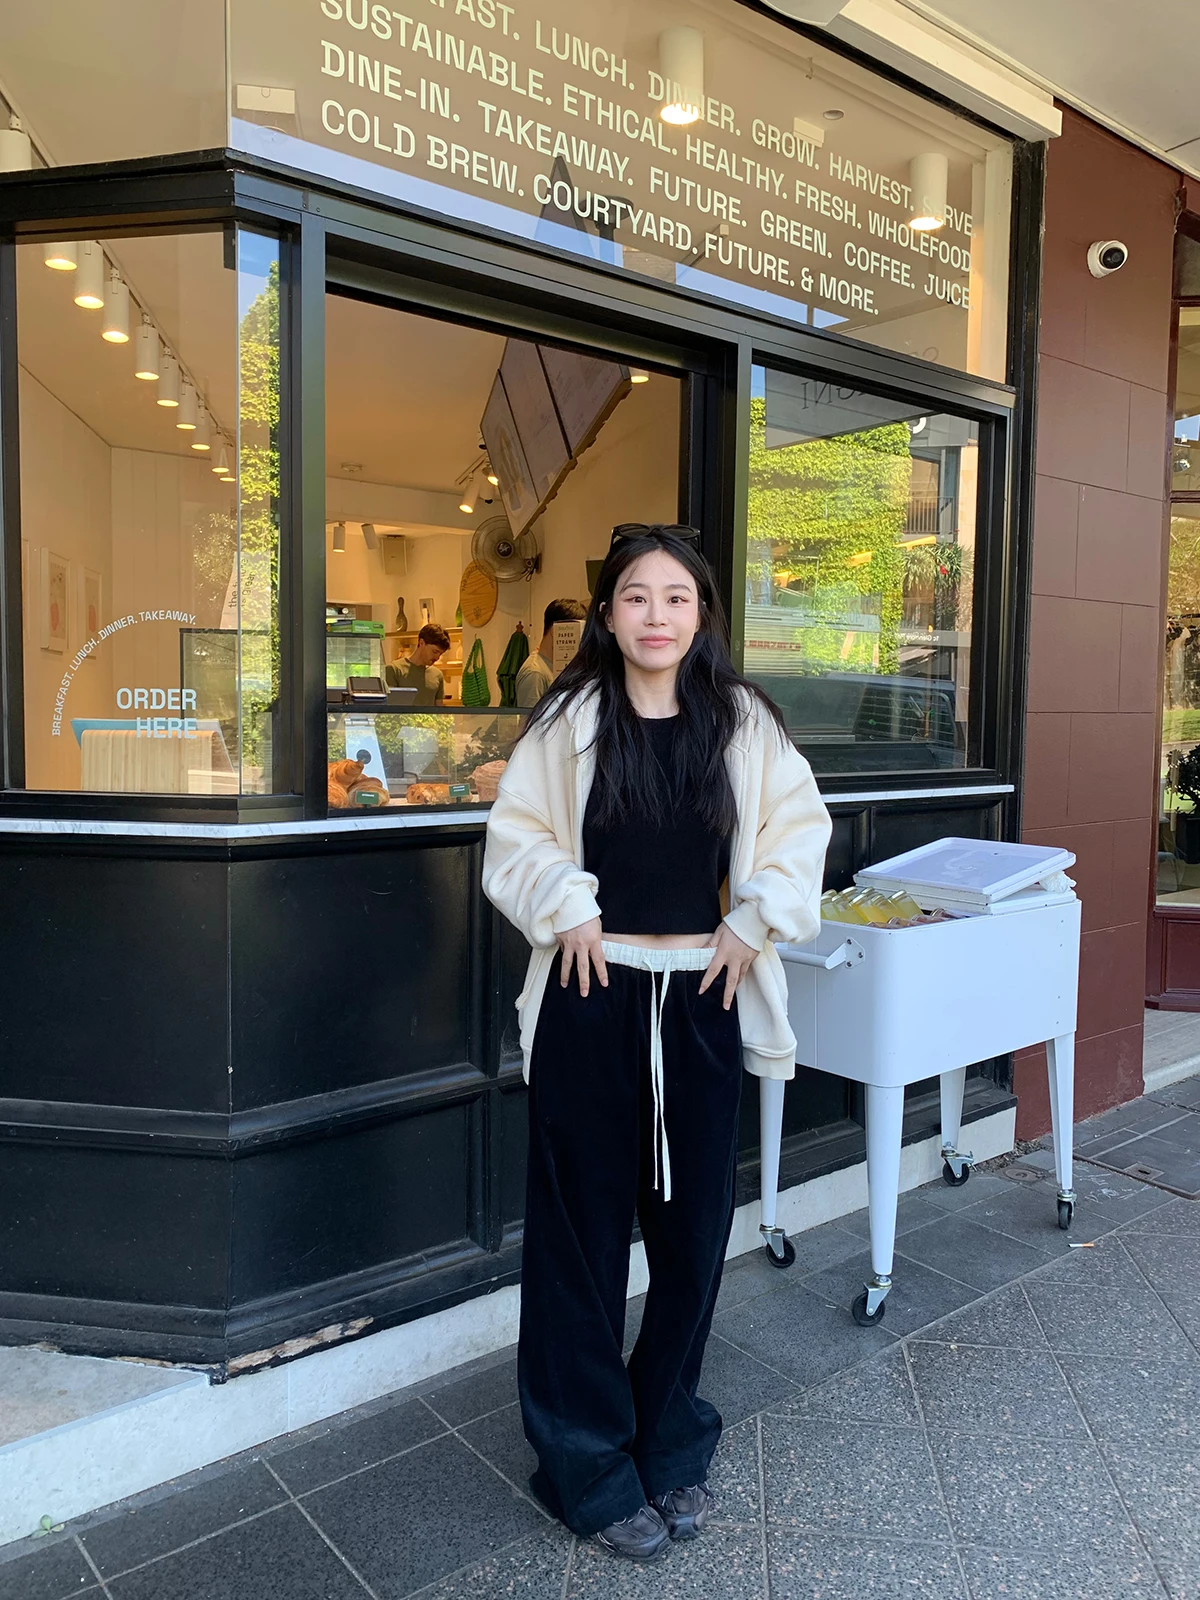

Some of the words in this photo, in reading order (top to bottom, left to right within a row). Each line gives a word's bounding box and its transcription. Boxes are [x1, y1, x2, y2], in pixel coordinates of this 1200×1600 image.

[320, 0, 552, 106] SUSTAINABLE.
[563, 82, 678, 156] ETHICAL.
[686, 134, 788, 199] HEALTHY.
[795, 179, 862, 231] FRESH.
[320, 39, 461, 123] DINE-IN.
[477, 100, 634, 186] TAKEAWAY.
[650, 166, 747, 228] FUTURE.
[760, 210, 833, 259] GREEN.
[843, 242, 916, 290] COFFEE.
[321, 99, 416, 159] COLD
[426, 134, 524, 197] BREW.
[533, 173, 698, 255] COURTYARD.
[704, 233, 795, 287] FUTURE.
[800, 267, 814, 294] &
[819, 272, 879, 316] MORE.
[535, 20, 635, 91] LUNCH.
[647, 70, 741, 136] DINNER.
[751, 118, 820, 171] GROW.
[829, 153, 915, 212] HARVEST.
[52, 671, 75, 736] BREAKFAST.
[69, 637, 100, 671] LUNCH.
[97, 614, 138, 641] DINNER.
[138, 610, 196, 625] TAKEAWAY.
[116, 687, 197, 711] ORDER
[136, 716, 197, 739] HERE
